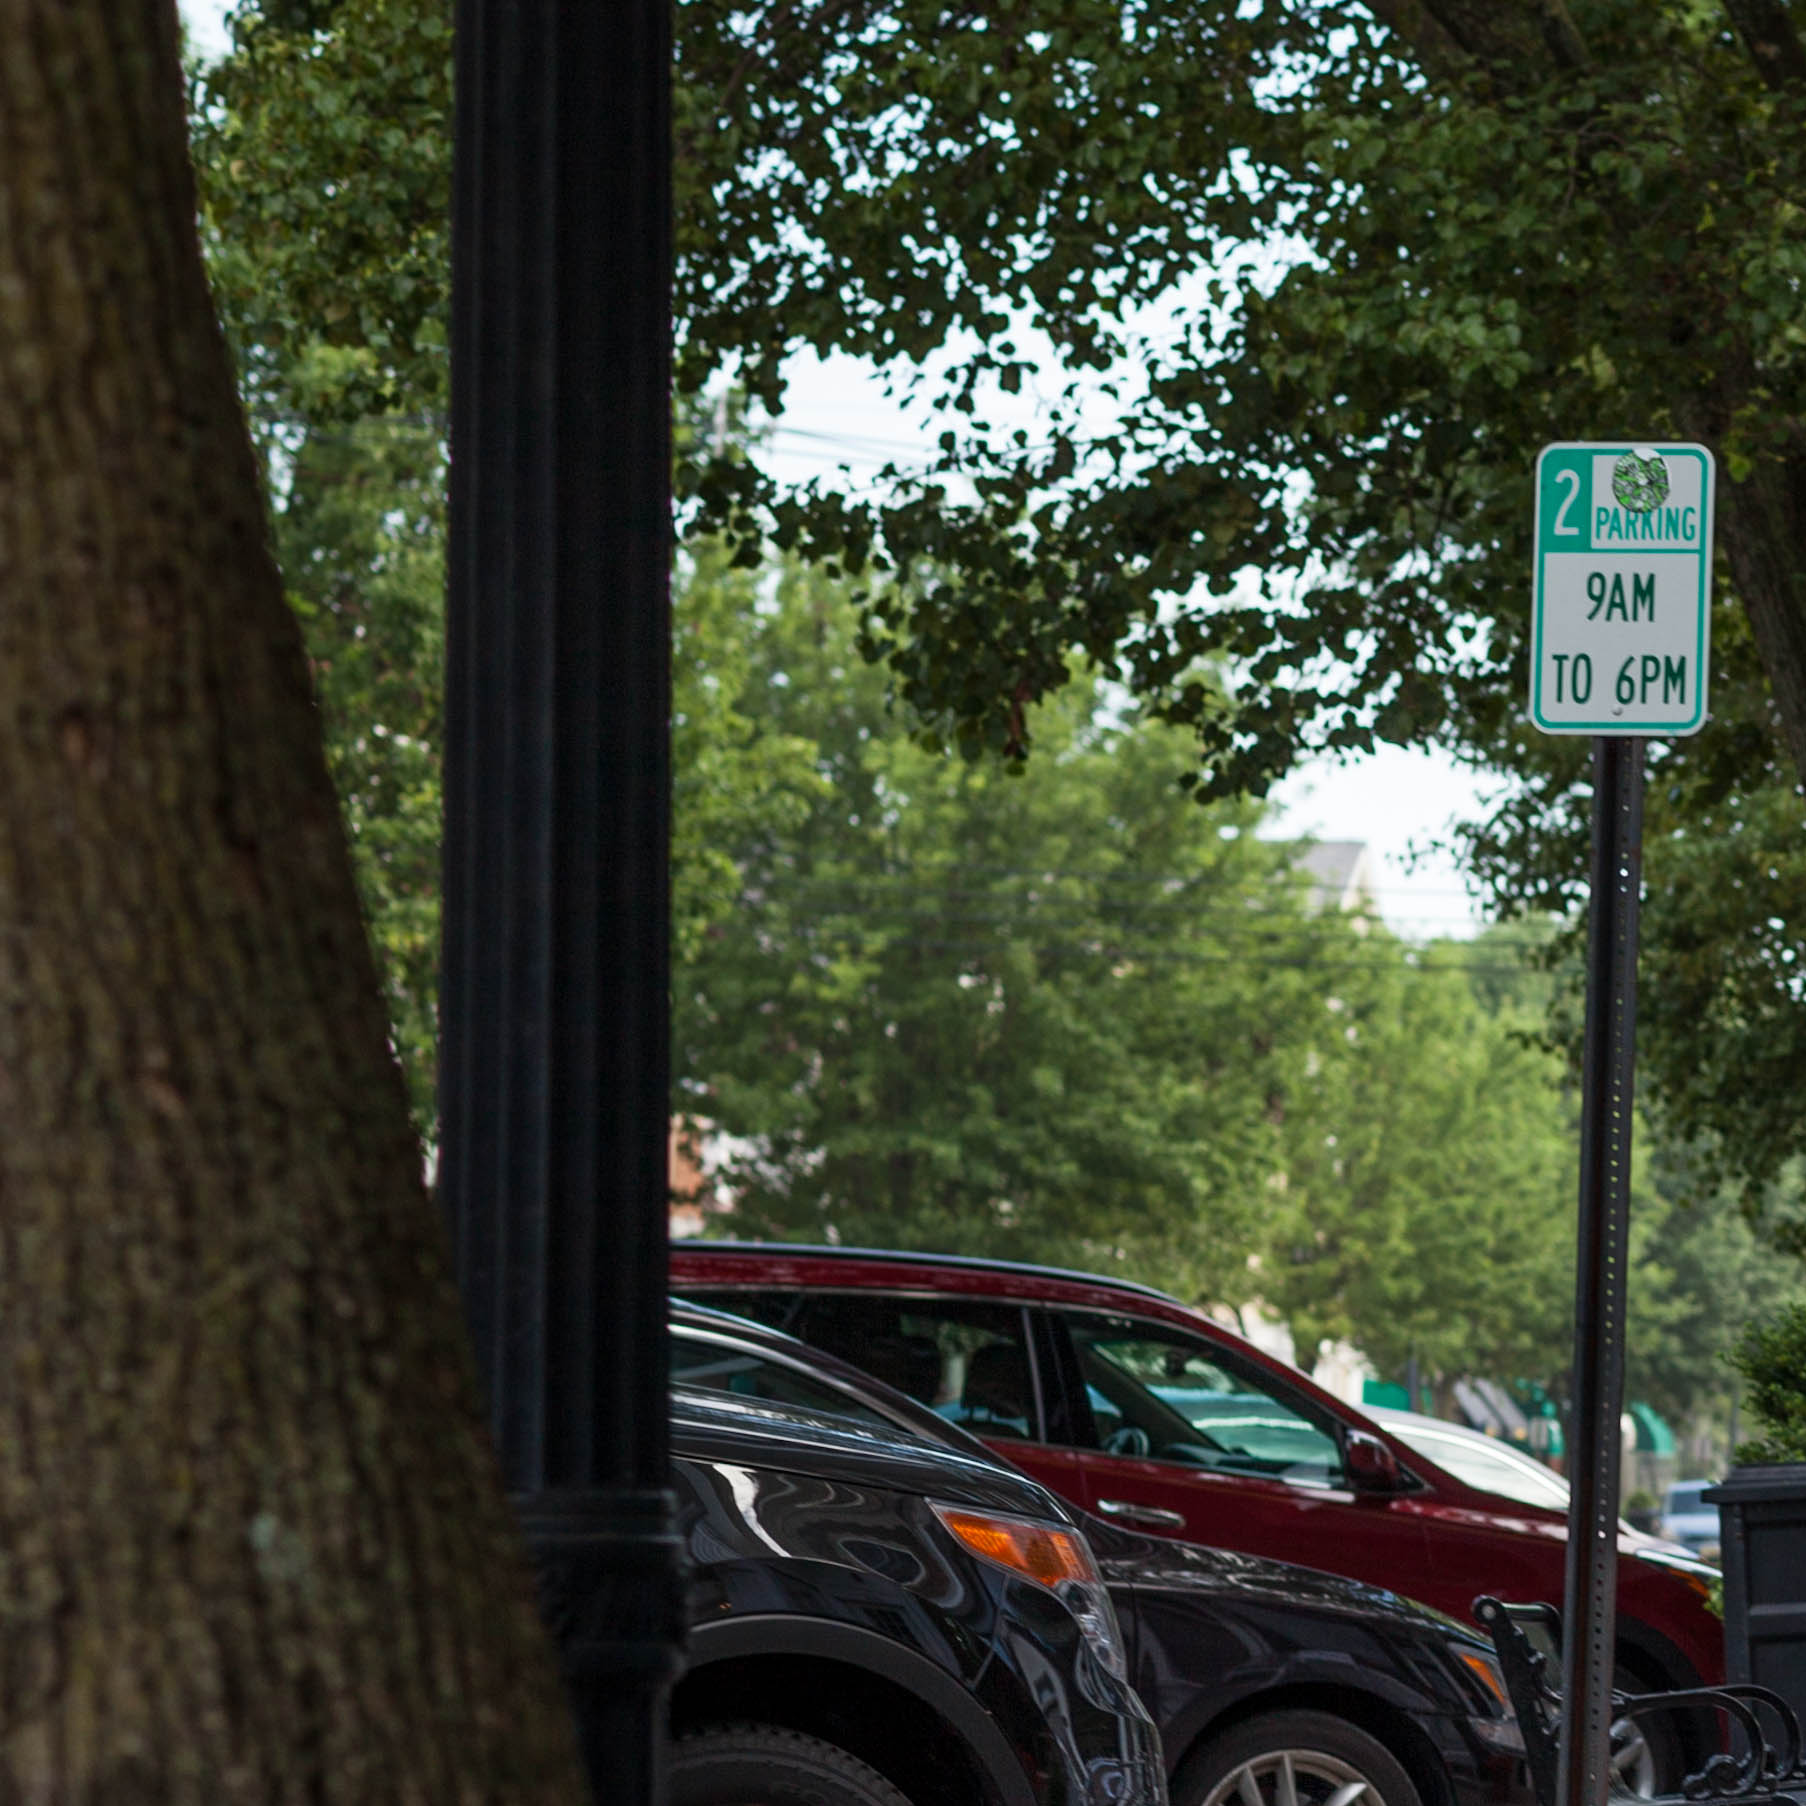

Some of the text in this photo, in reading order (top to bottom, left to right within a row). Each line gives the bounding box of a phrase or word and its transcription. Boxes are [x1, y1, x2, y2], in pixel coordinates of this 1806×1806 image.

[1553, 469, 1581, 536] 2
[1596, 506, 1697, 542] PARKING
[1586, 571, 1657, 623] 9AM
[1552, 653, 1687, 705] TO 6PM
